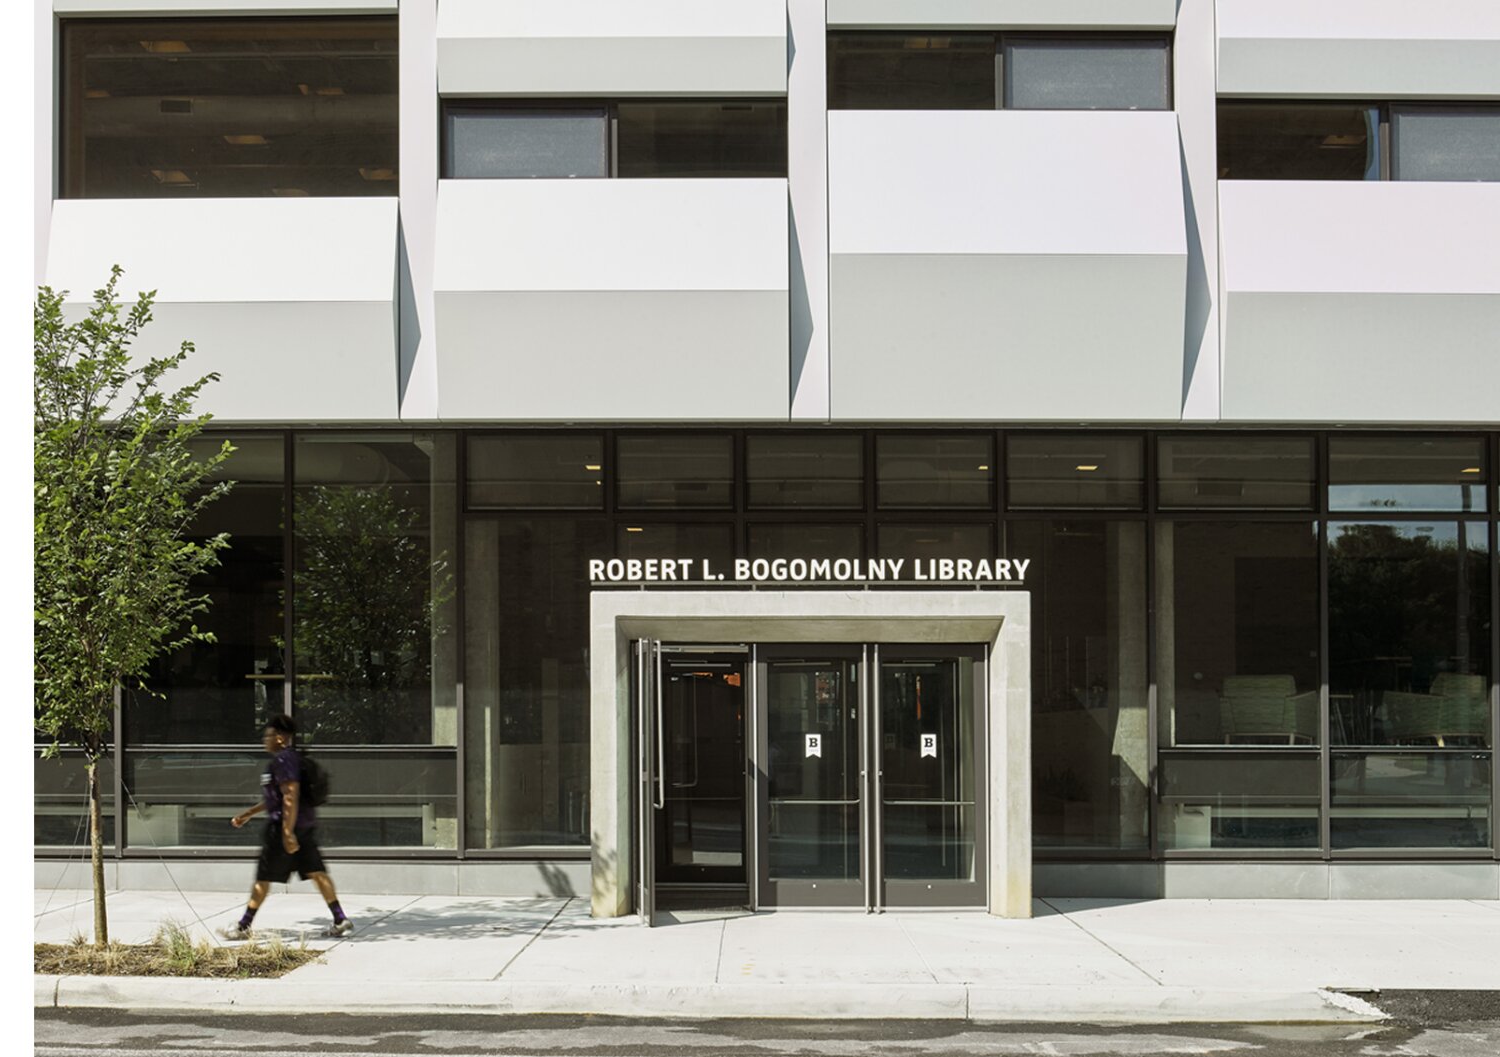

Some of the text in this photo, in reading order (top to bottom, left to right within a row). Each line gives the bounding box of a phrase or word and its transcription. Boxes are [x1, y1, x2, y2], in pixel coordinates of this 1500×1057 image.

[589, 558, 1031, 581] ROBERT L. BOGOMOLNY LIBRARY
[808, 737, 818, 748] B
[923, 737, 933, 748] B
